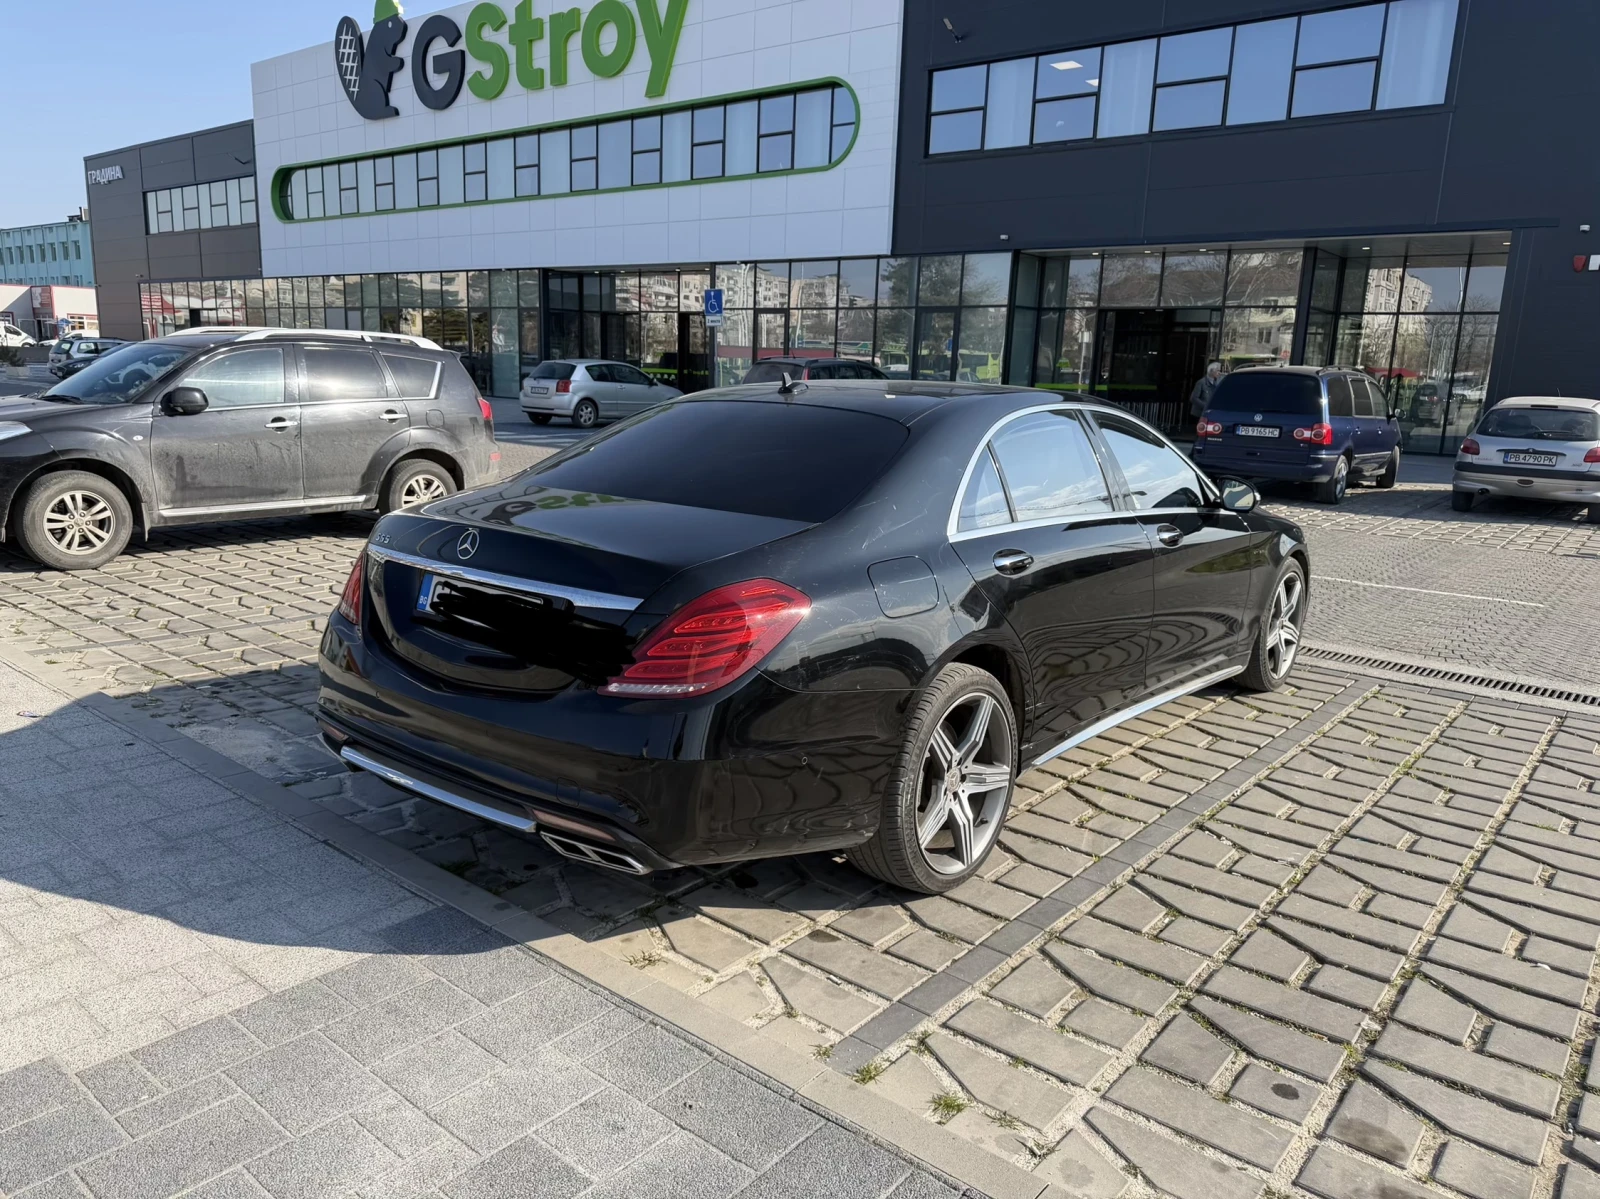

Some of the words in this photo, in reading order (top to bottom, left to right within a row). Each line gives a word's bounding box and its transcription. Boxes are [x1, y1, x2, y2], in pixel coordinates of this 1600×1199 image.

[87, 165, 123, 185] ГРАДИНА
[1509, 453, 1520, 462] PB
[1522, 454, 1542, 463] 4790
[1543, 456, 1555, 464] PK
[419, 595, 428, 605] BG
